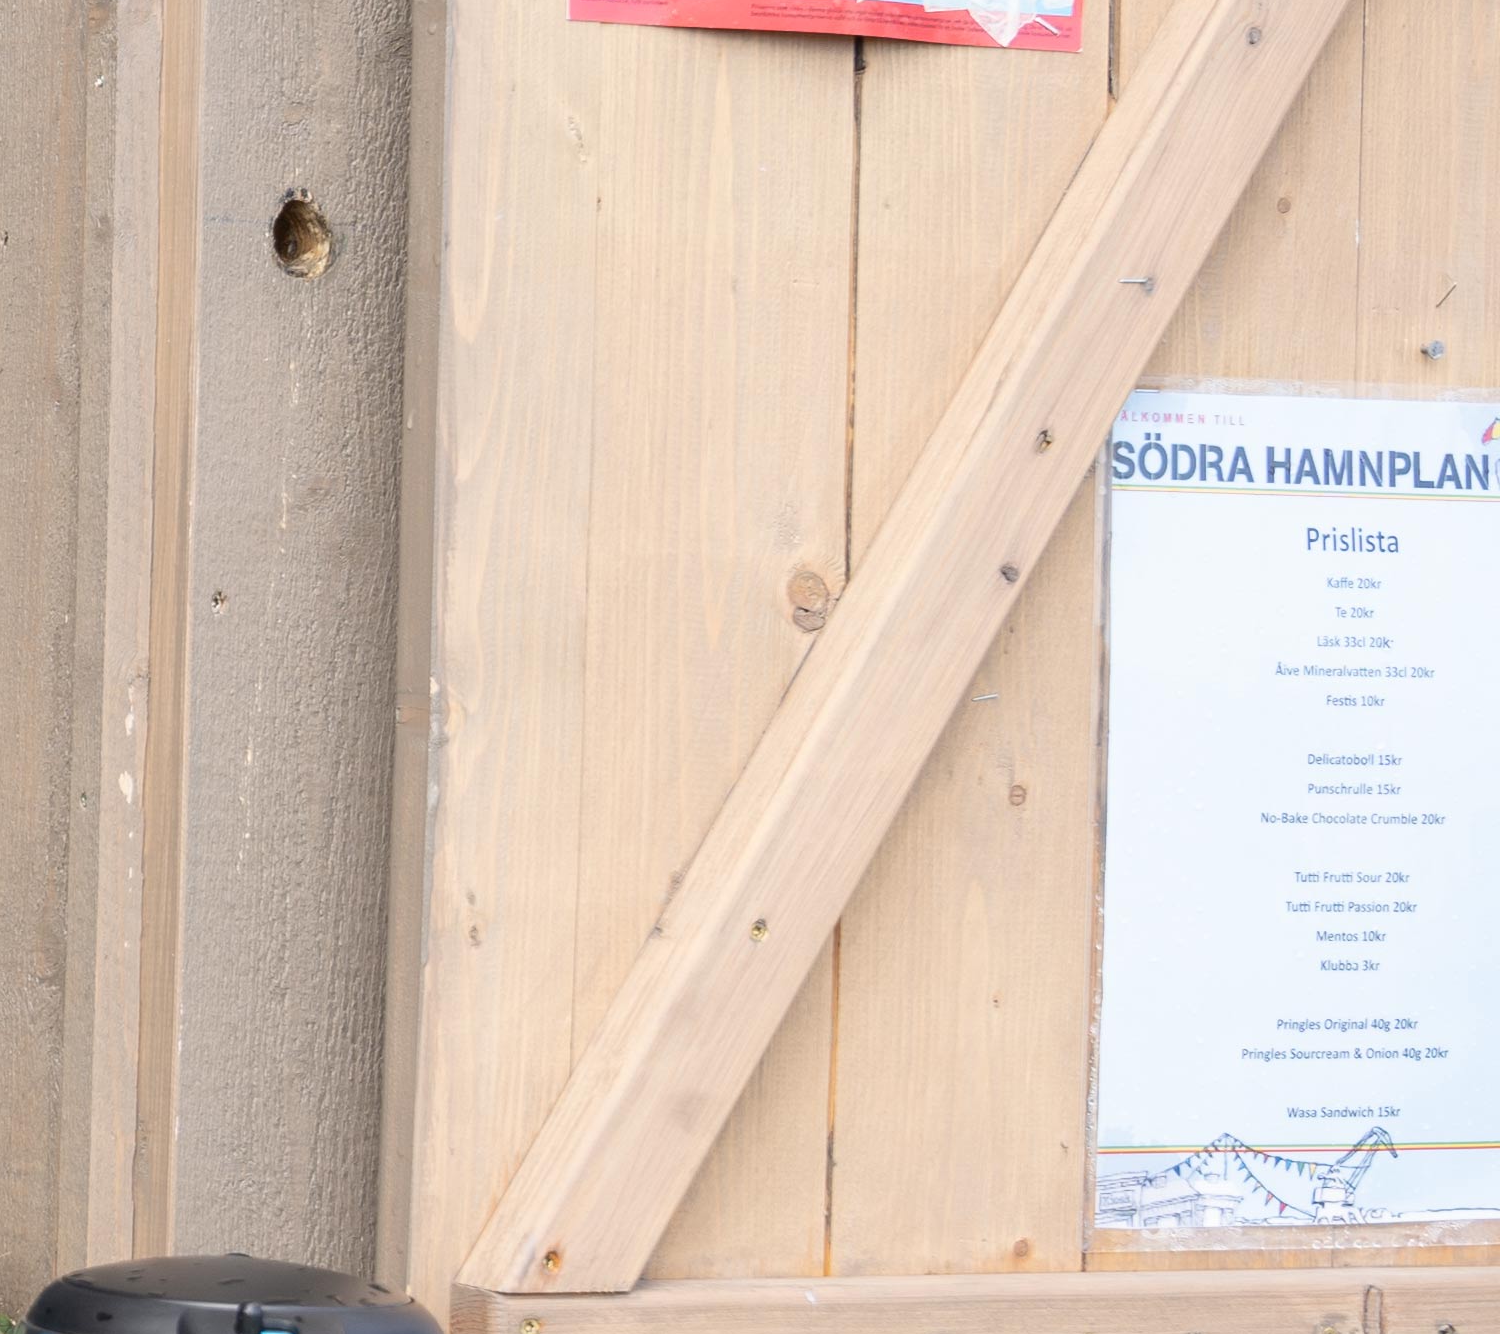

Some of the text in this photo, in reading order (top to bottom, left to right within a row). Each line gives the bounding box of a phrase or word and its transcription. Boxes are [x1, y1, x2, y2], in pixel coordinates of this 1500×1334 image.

[1119, 410, 1246, 427] ÄLKOMMEN TILL
[1112, 432, 1490, 491] SÖDRA HAMNPLAN
[1306, 526, 1400, 554] Prislista
[1326, 576, 1382, 591] Kaffe 20kr
[1335, 606, 1374, 620] Te 20kr
[1316, 634, 1394, 650] Läsk 33cl 20kr
[1302, 663, 1382, 679] Mineralvatten
[1384, 665, 1407, 680] 33cl
[1410, 666, 1436, 680] 20kr
[1325, 693, 1386, 708] Festis 10kr
[1306, 752, 1403, 767] Delicatoboll 15kr
[1306, 782, 1402, 797] Punschrulle 15kr
[1260, 811, 1446, 827] No-Bake Chocolate Crumble 20kr
[1294, 870, 1410, 885] Tutti Frutti Sour 20kr
[1285, 900, 1418, 914] Tutti Frutti Passion 20kr
[1315, 929, 1387, 943] Mentos 10kr
[1320, 958, 1381, 973] Klubba 3kr
[1276, 1017, 1419, 1034] Pringles Original 40g 20kr
[1241, 1046, 1450, 1064] Pringles Sourcream & Onion 40g 20kr
[1287, 1105, 1401, 1120] Wasa Sandwich 15kr
